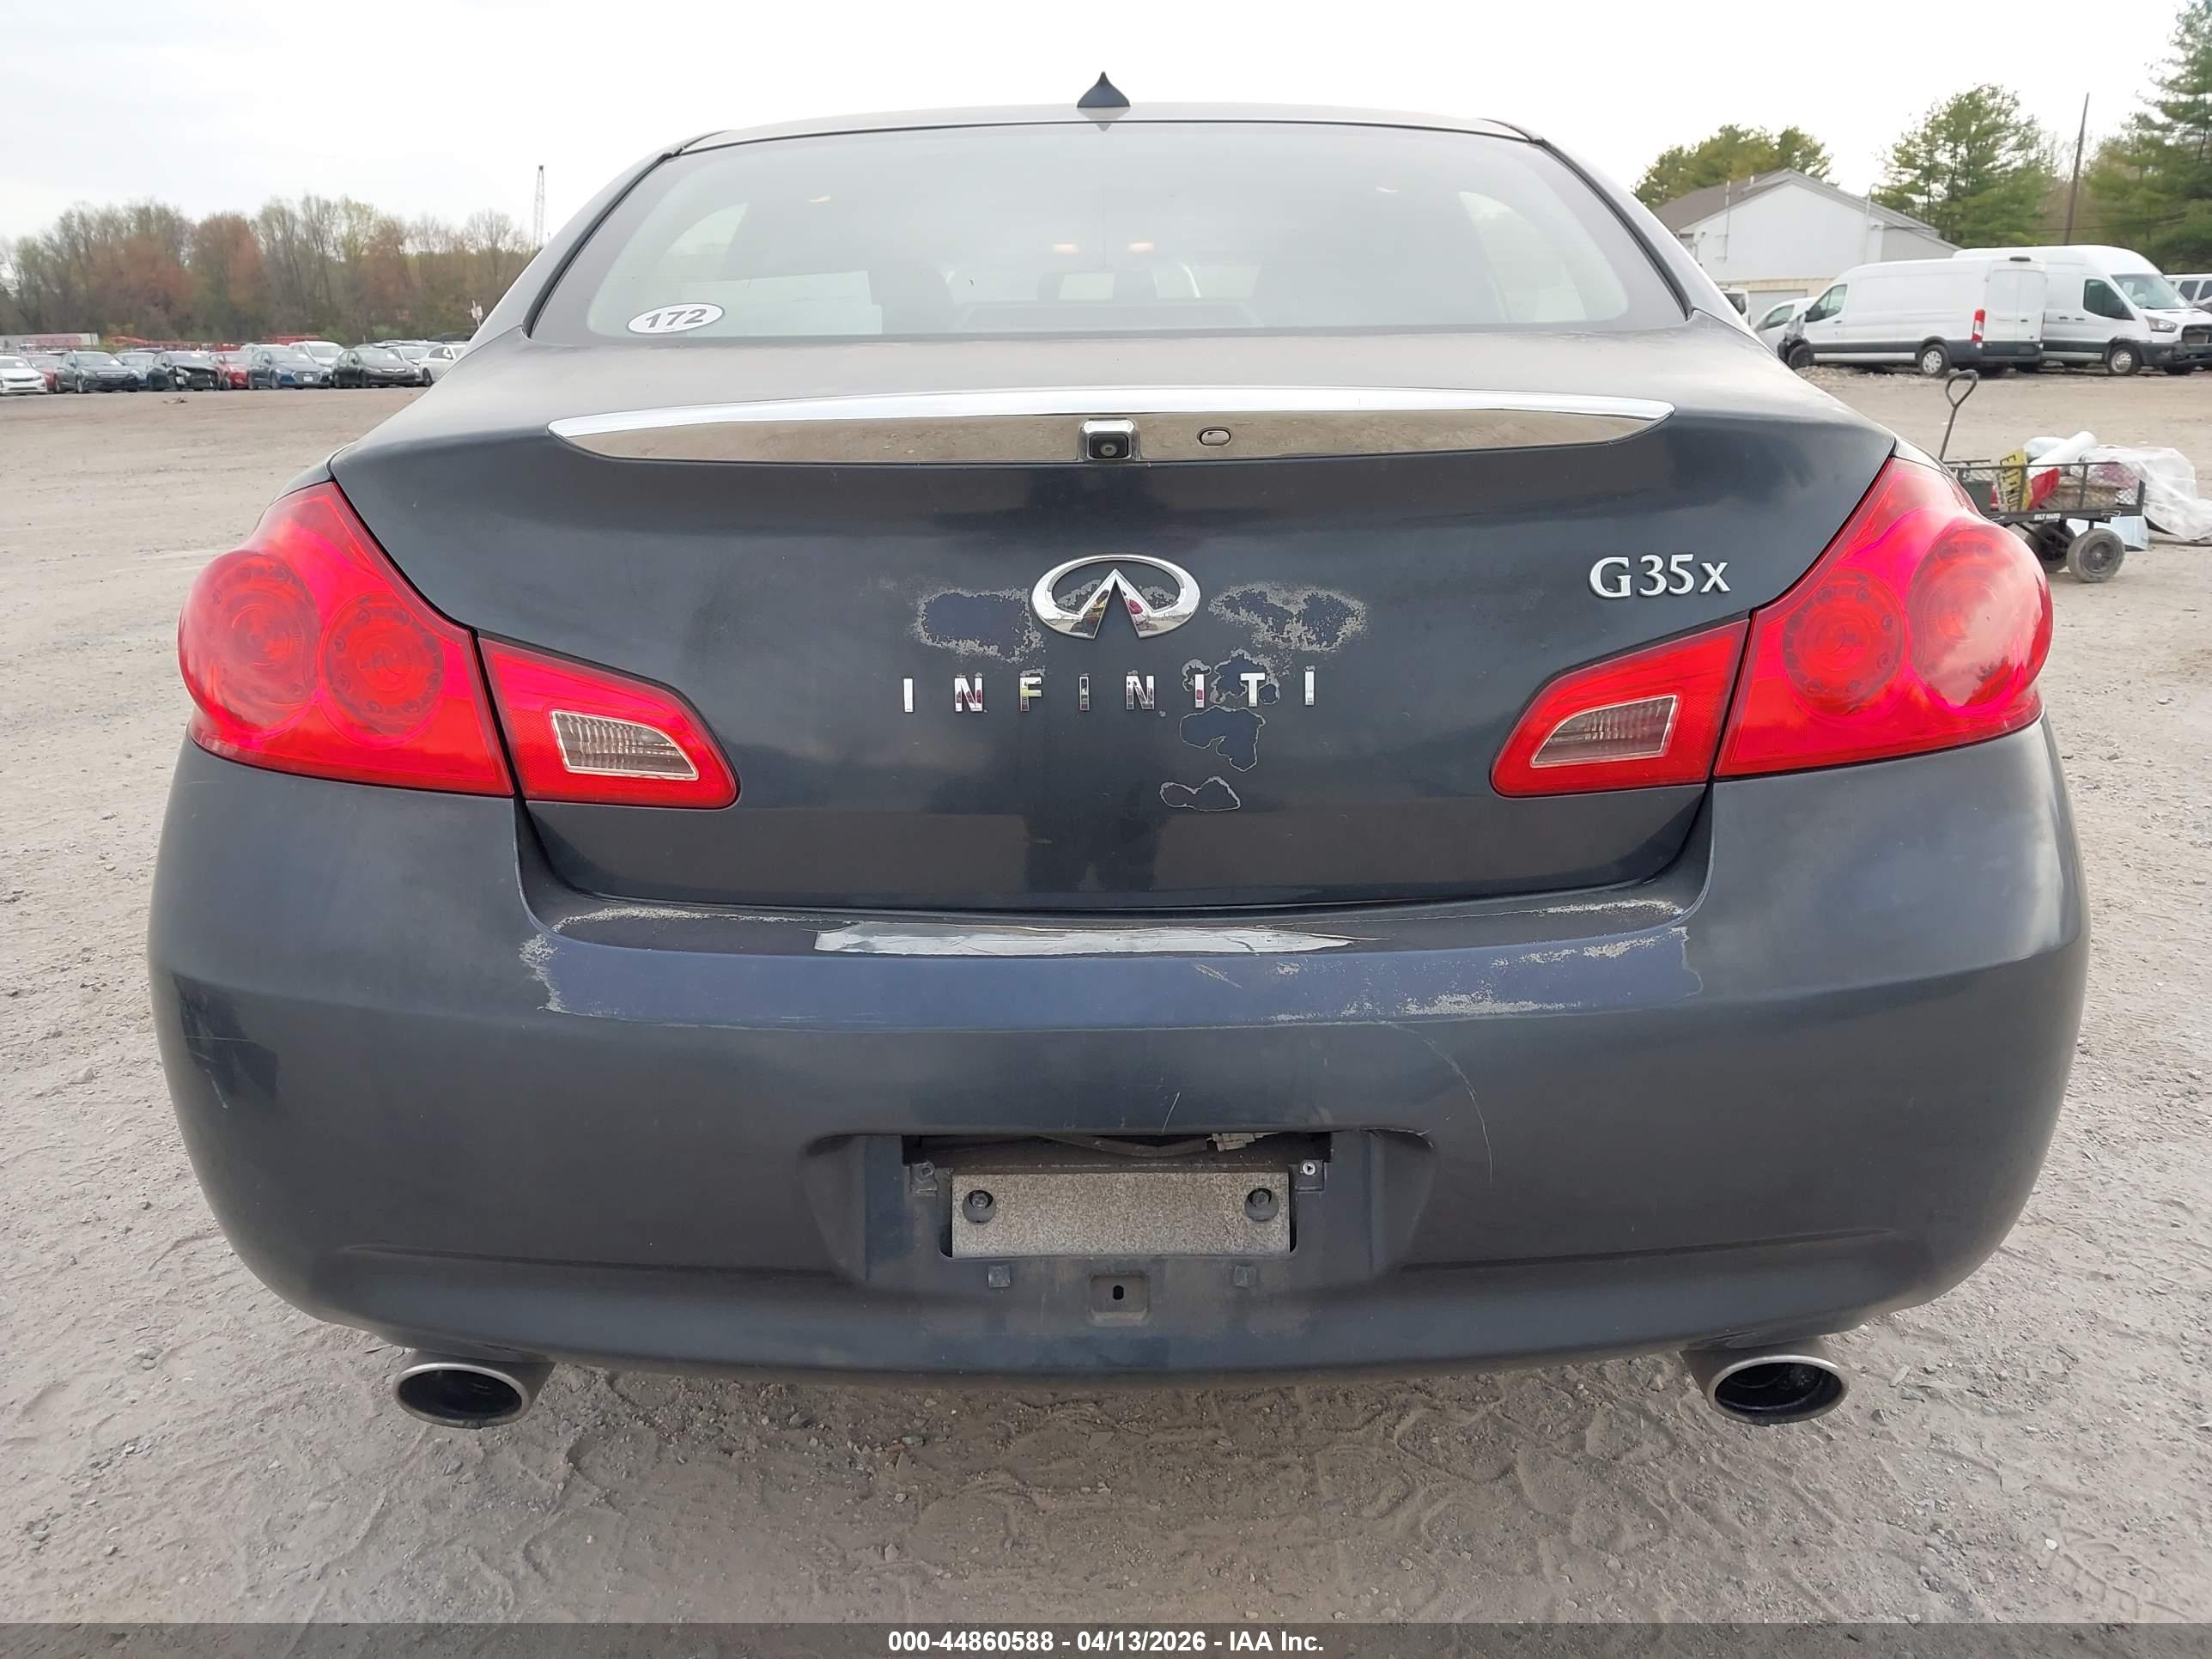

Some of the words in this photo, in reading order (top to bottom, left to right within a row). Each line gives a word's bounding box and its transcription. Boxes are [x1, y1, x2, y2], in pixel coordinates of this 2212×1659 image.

[645, 308, 708, 329] 172
[1589, 553, 1731, 599] G35x
[902, 670, 1316, 713] INFINITI
